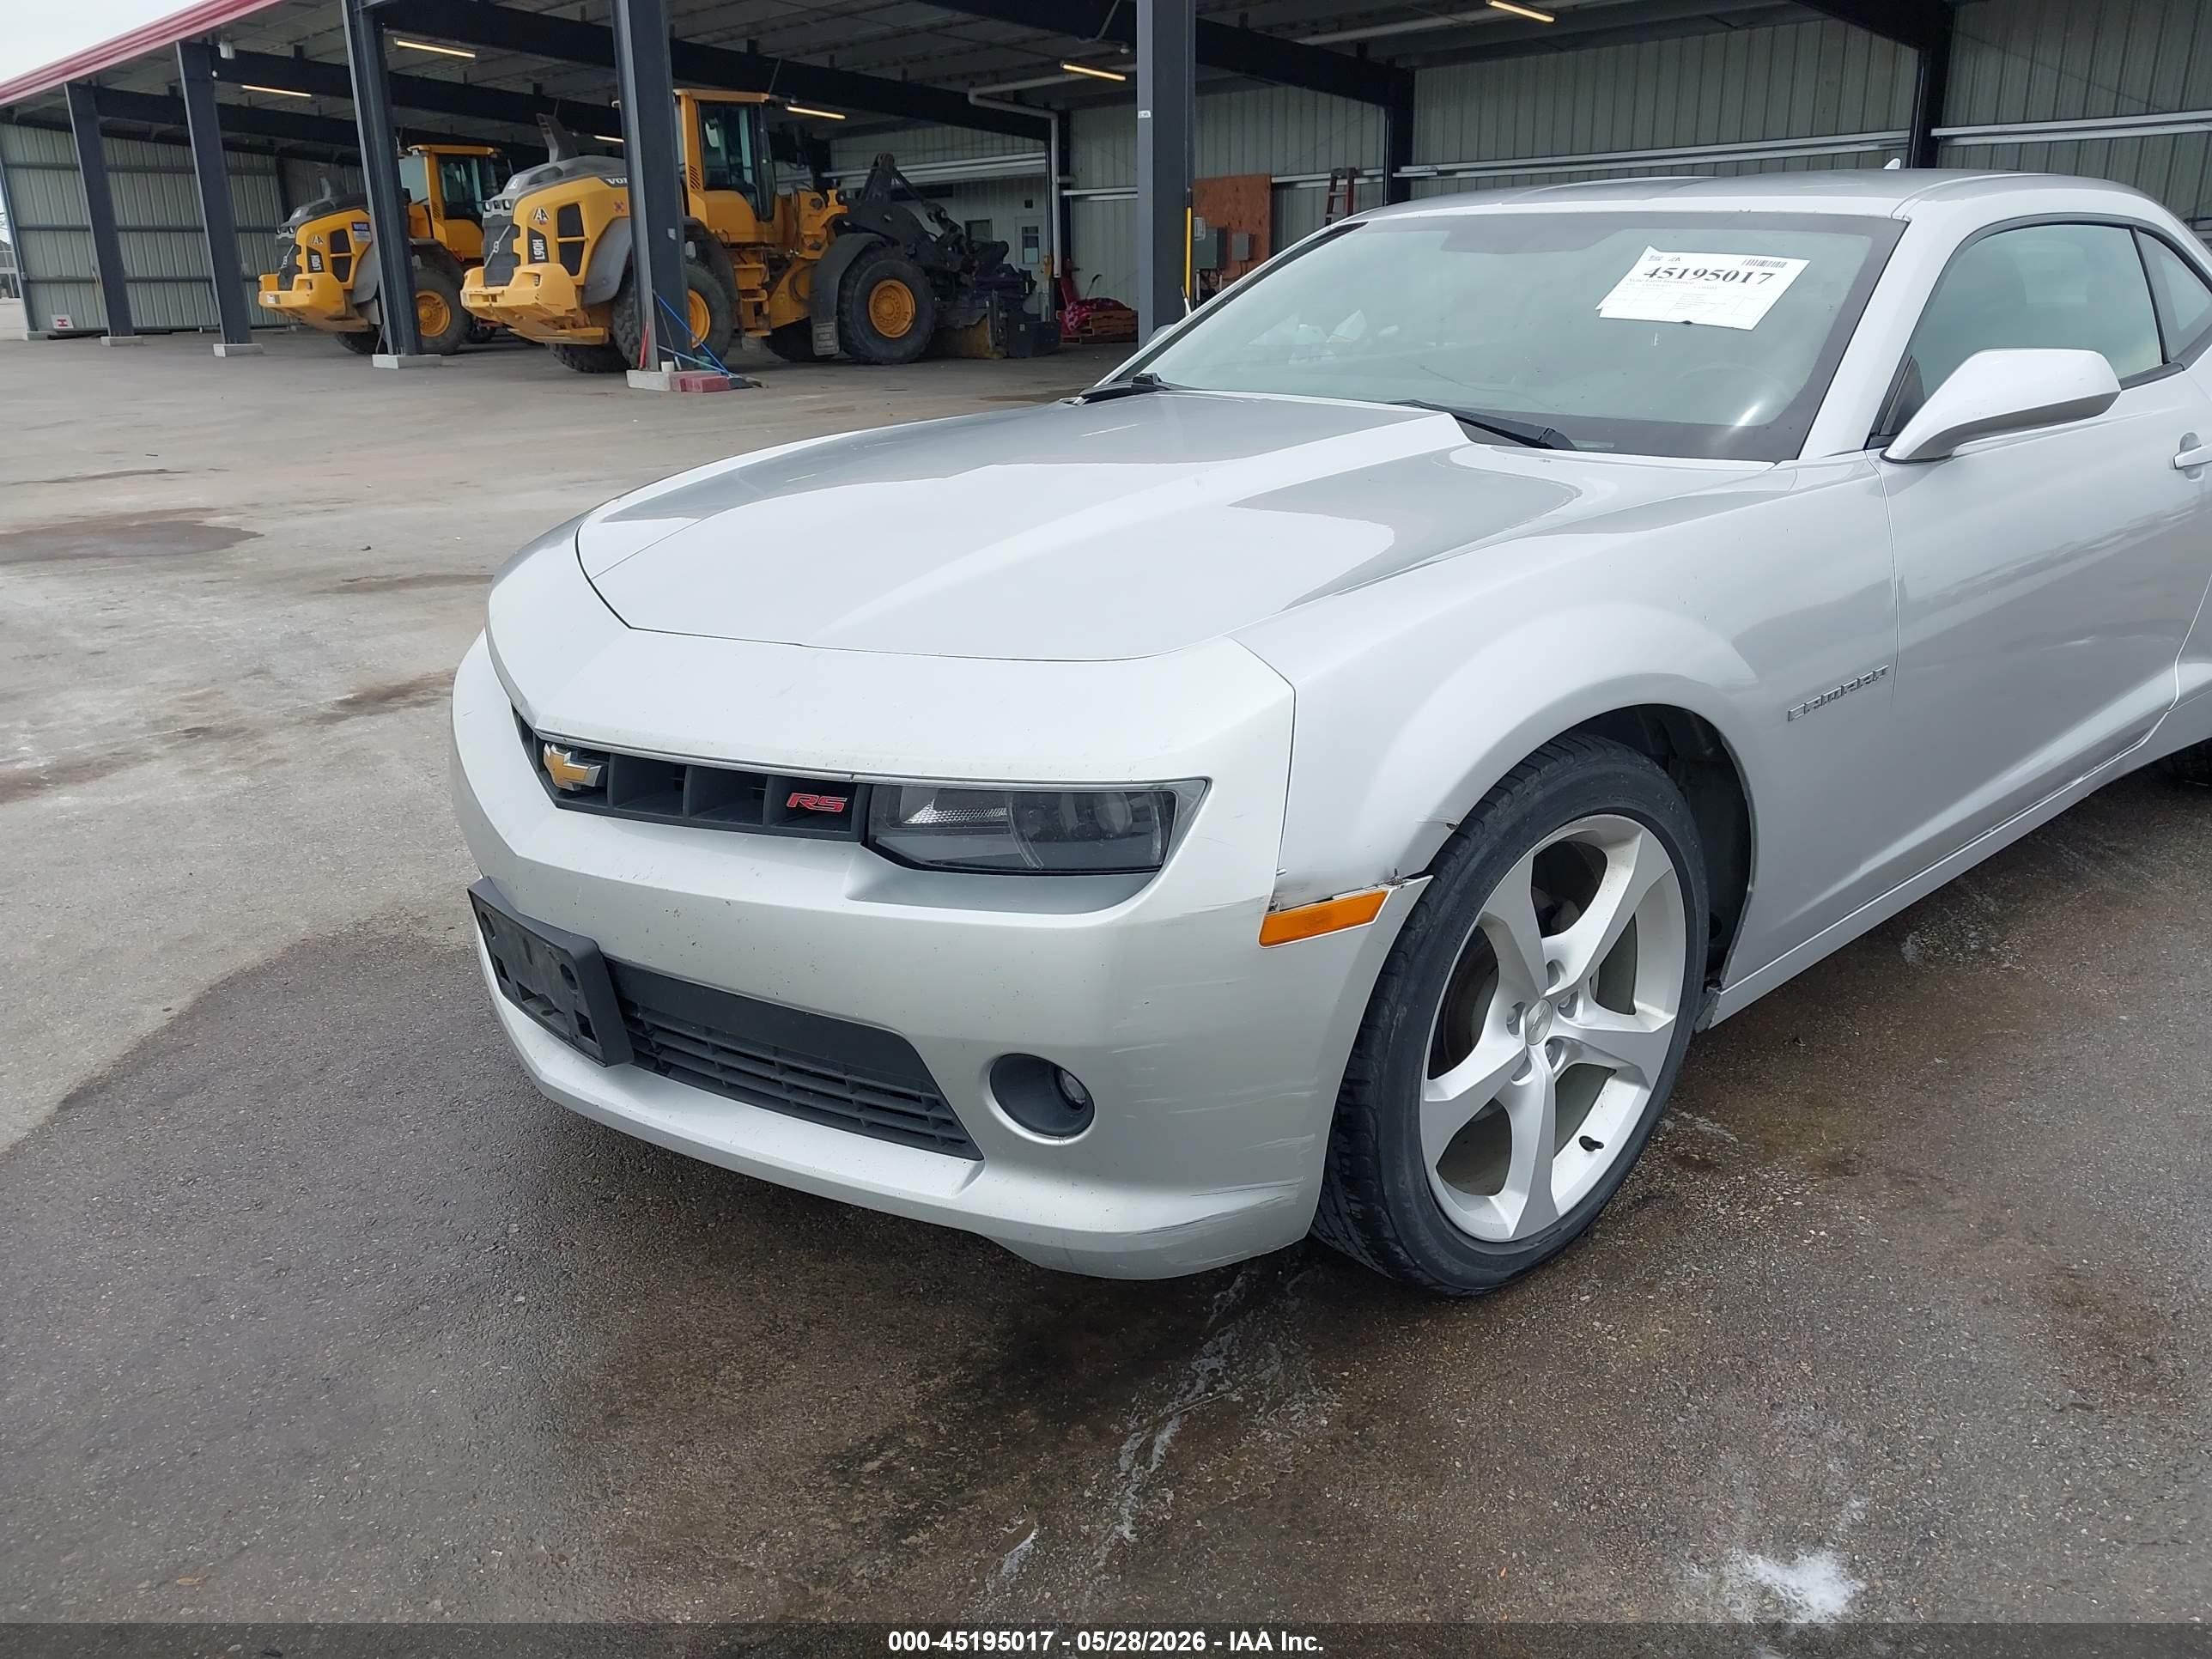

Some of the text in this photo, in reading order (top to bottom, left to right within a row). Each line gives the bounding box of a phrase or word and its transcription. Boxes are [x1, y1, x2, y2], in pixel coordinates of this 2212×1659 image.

[532, 239, 545, 261] L90H
[1644, 266, 1775, 285] 45195017
[786, 792, 848, 813] RS
